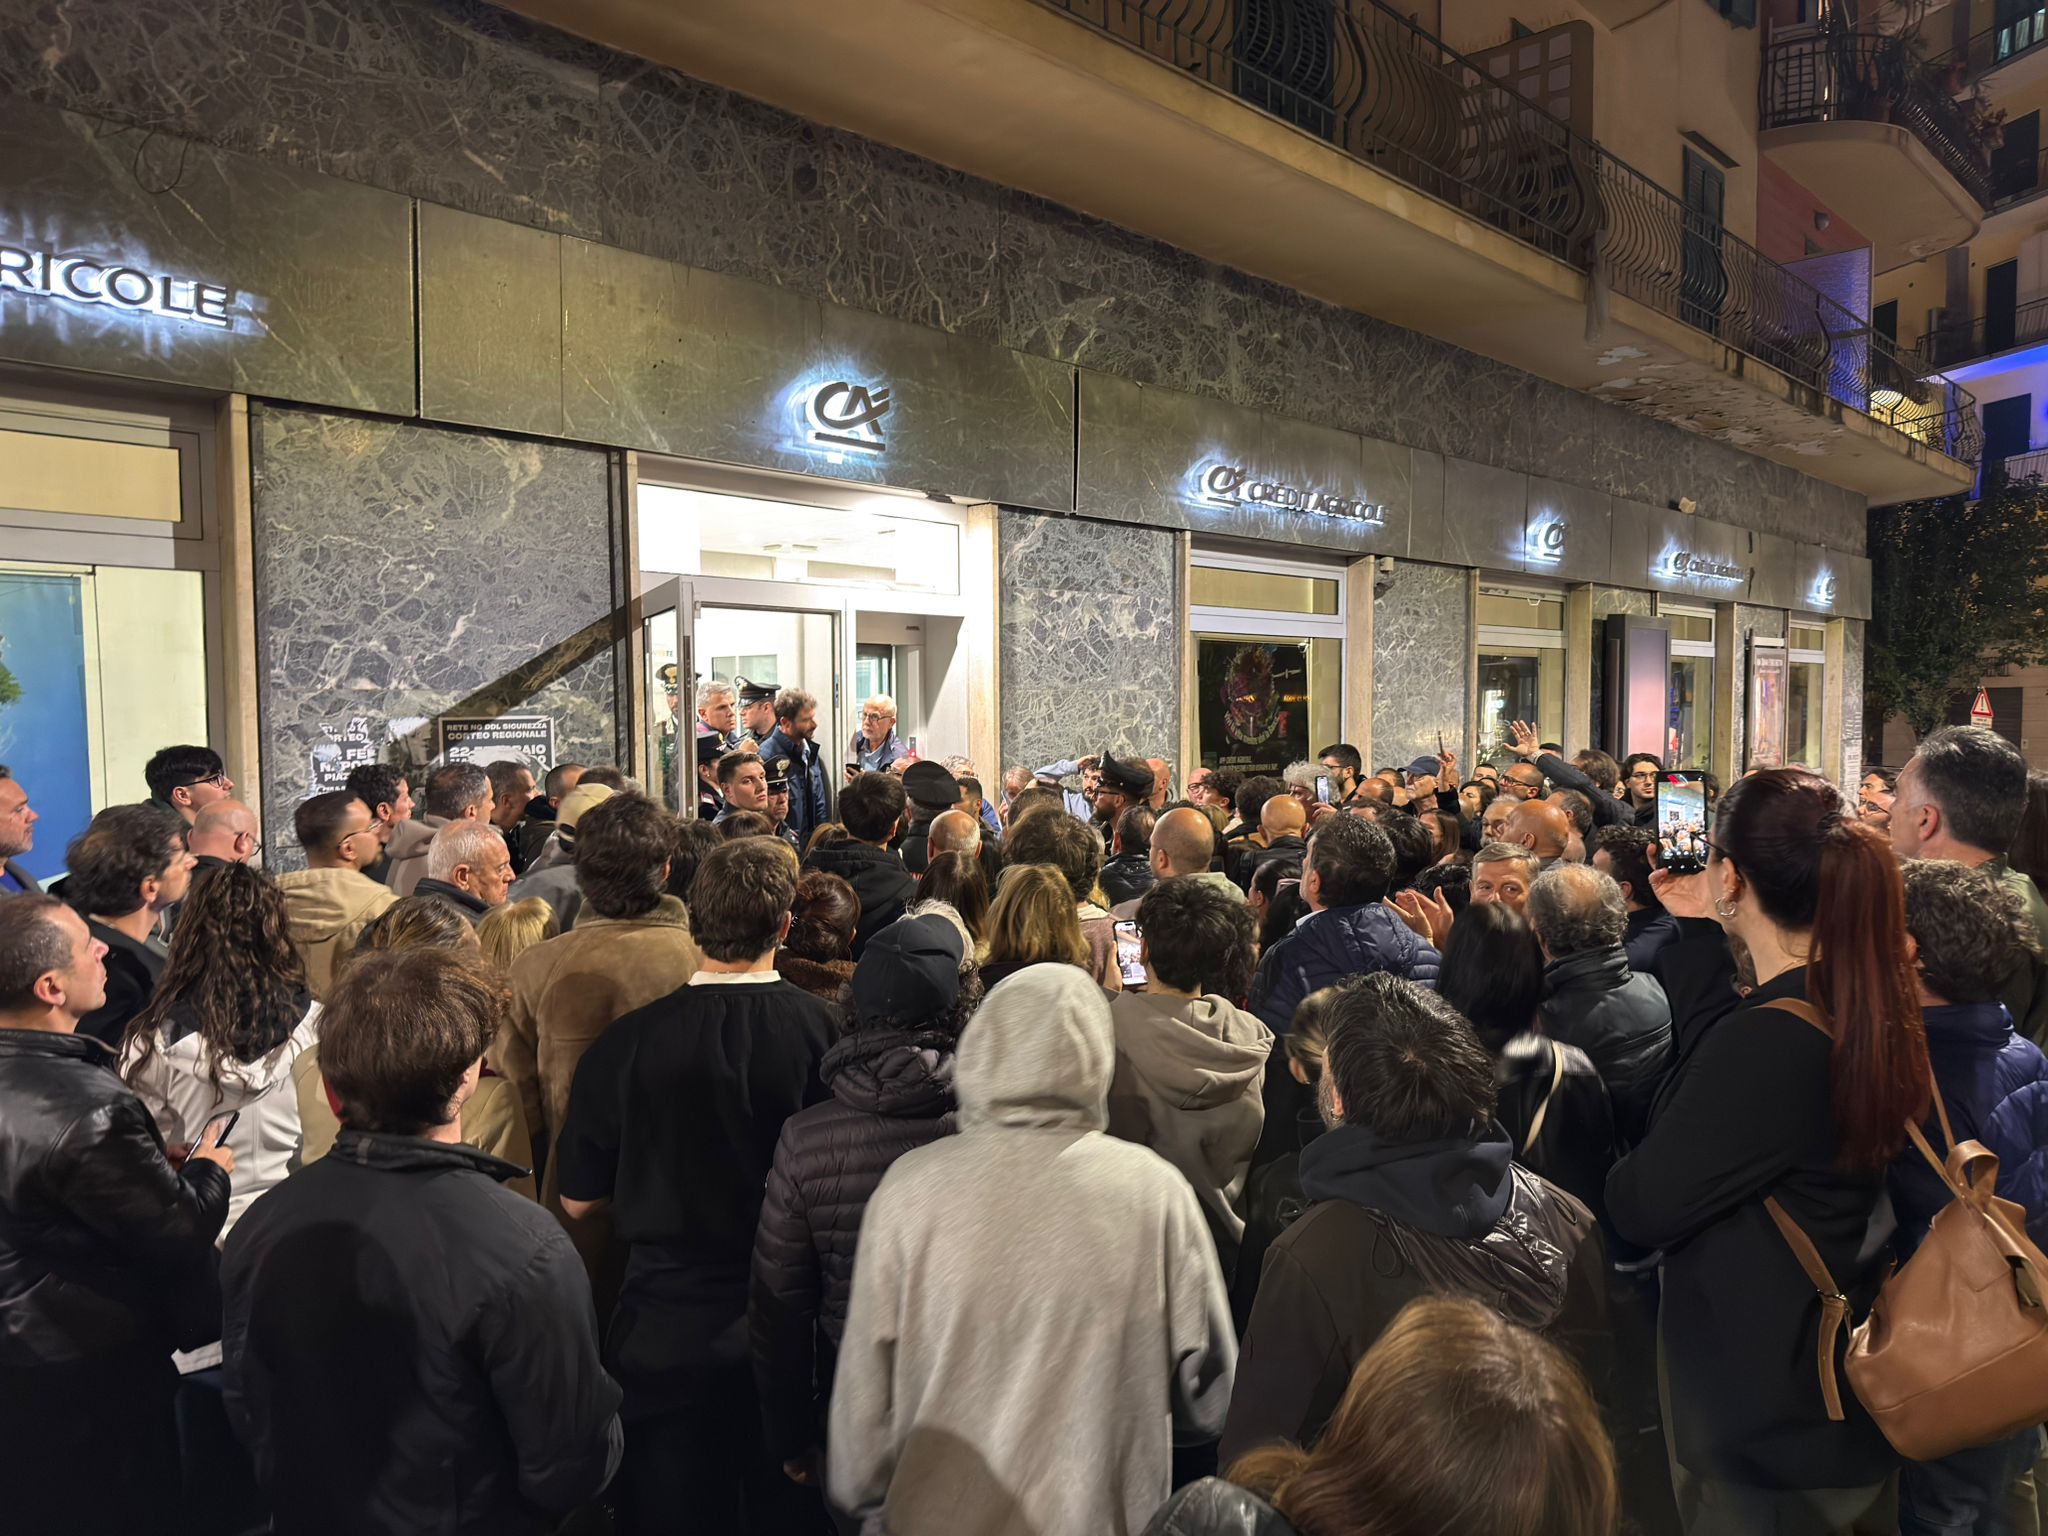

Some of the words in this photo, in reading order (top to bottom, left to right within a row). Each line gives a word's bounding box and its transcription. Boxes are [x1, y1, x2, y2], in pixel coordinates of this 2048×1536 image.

[502, 722, 547, 730] SICUREZZA
[492, 730, 547, 739] REGIONALE
[449, 746, 470, 758] 22
